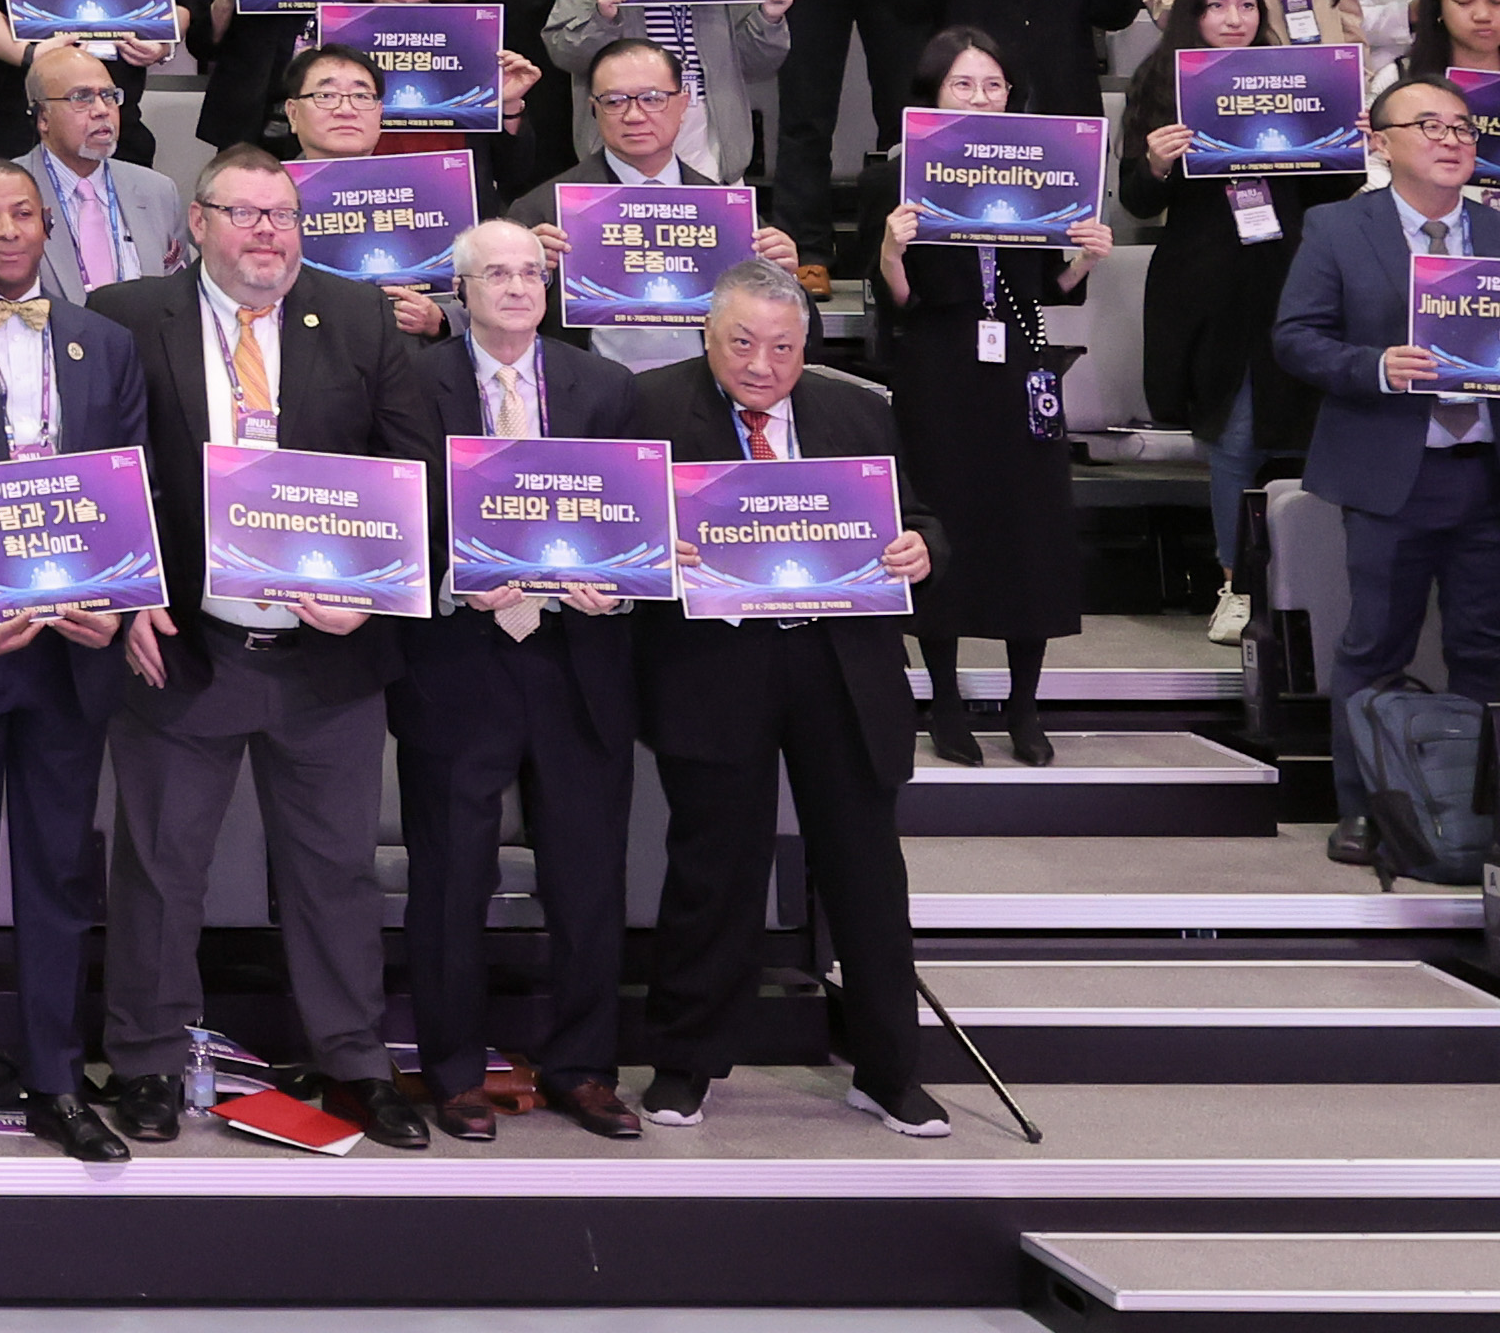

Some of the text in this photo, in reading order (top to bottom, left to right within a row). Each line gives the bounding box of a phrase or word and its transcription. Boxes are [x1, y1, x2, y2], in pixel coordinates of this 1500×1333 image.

[963, 143, 1044, 161] 기업가정신은
[925, 161, 1079, 190] Hospitality이다.
[619, 203, 698, 220] 기업가정신은
[601, 223, 717, 249] 포용, 다양성
[623, 250, 699, 273] 존중이다.
[514, 473, 604, 492] 기업가정신은
[271, 484, 359, 508] 기업가정신은
[480, 495, 640, 523] 신뢰와 협력이다.
[739, 494, 830, 513] 기업가정신은
[50, 497, 106, 525] 기술,
[229, 503, 403, 540] Connection이다.
[697, 518, 878, 544] fascination이다.
[2, 531, 89, 559] 혁신이다.
